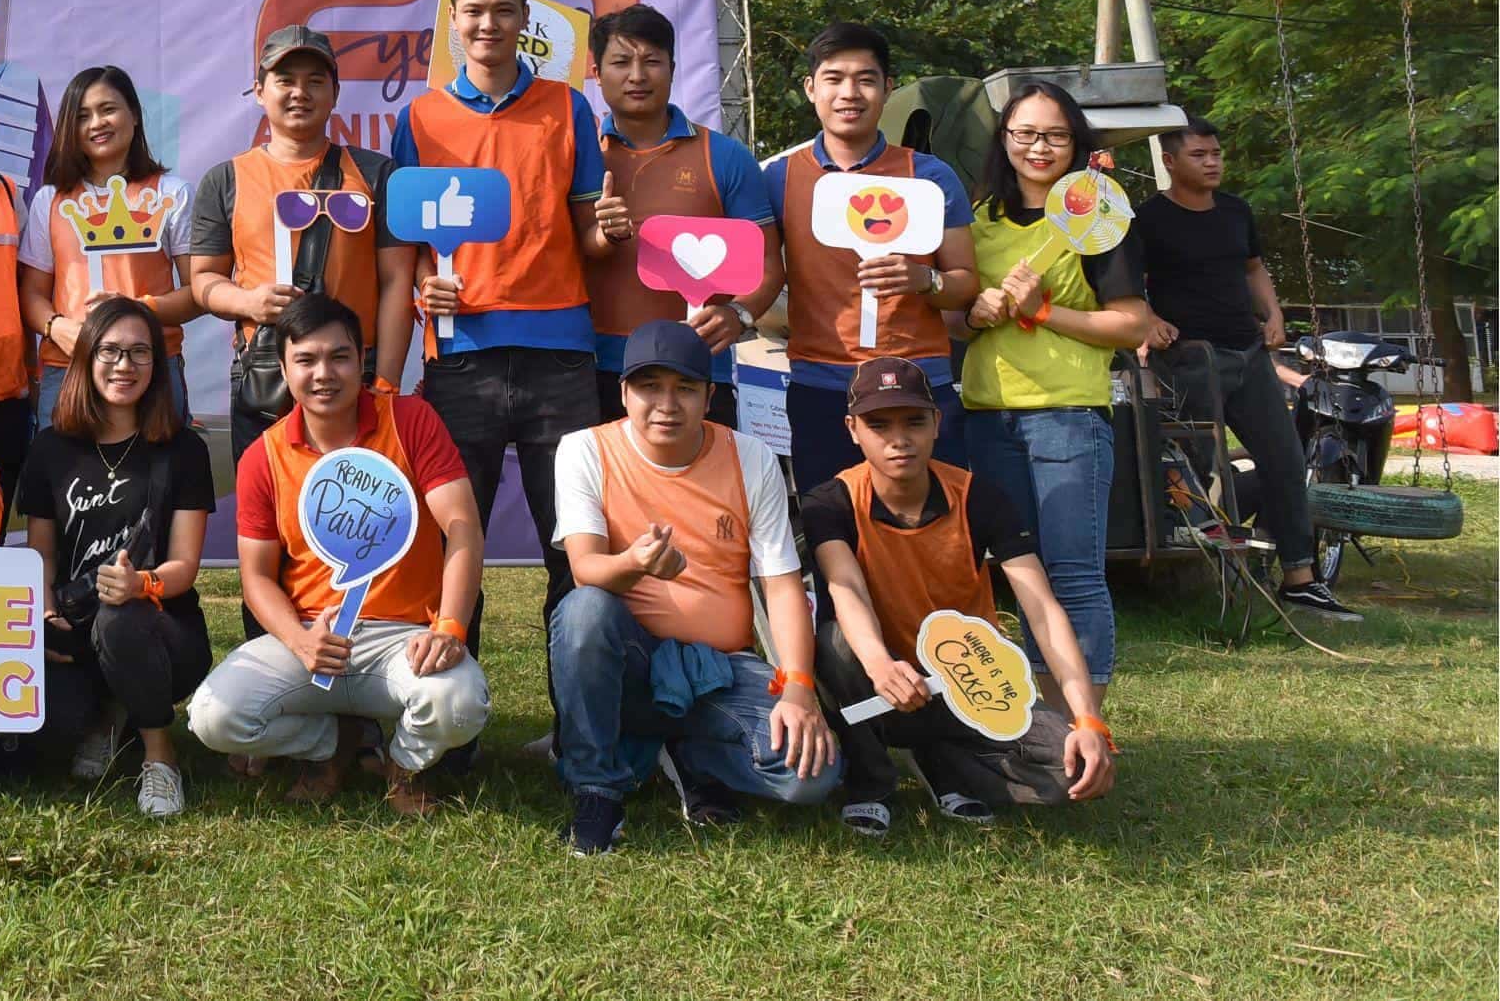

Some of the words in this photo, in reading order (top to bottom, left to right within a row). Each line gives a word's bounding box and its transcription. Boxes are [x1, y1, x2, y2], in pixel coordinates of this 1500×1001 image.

[64, 477, 131, 536] Saint
[311, 478, 397, 560] Party!
[382, 482, 403, 505] TO
